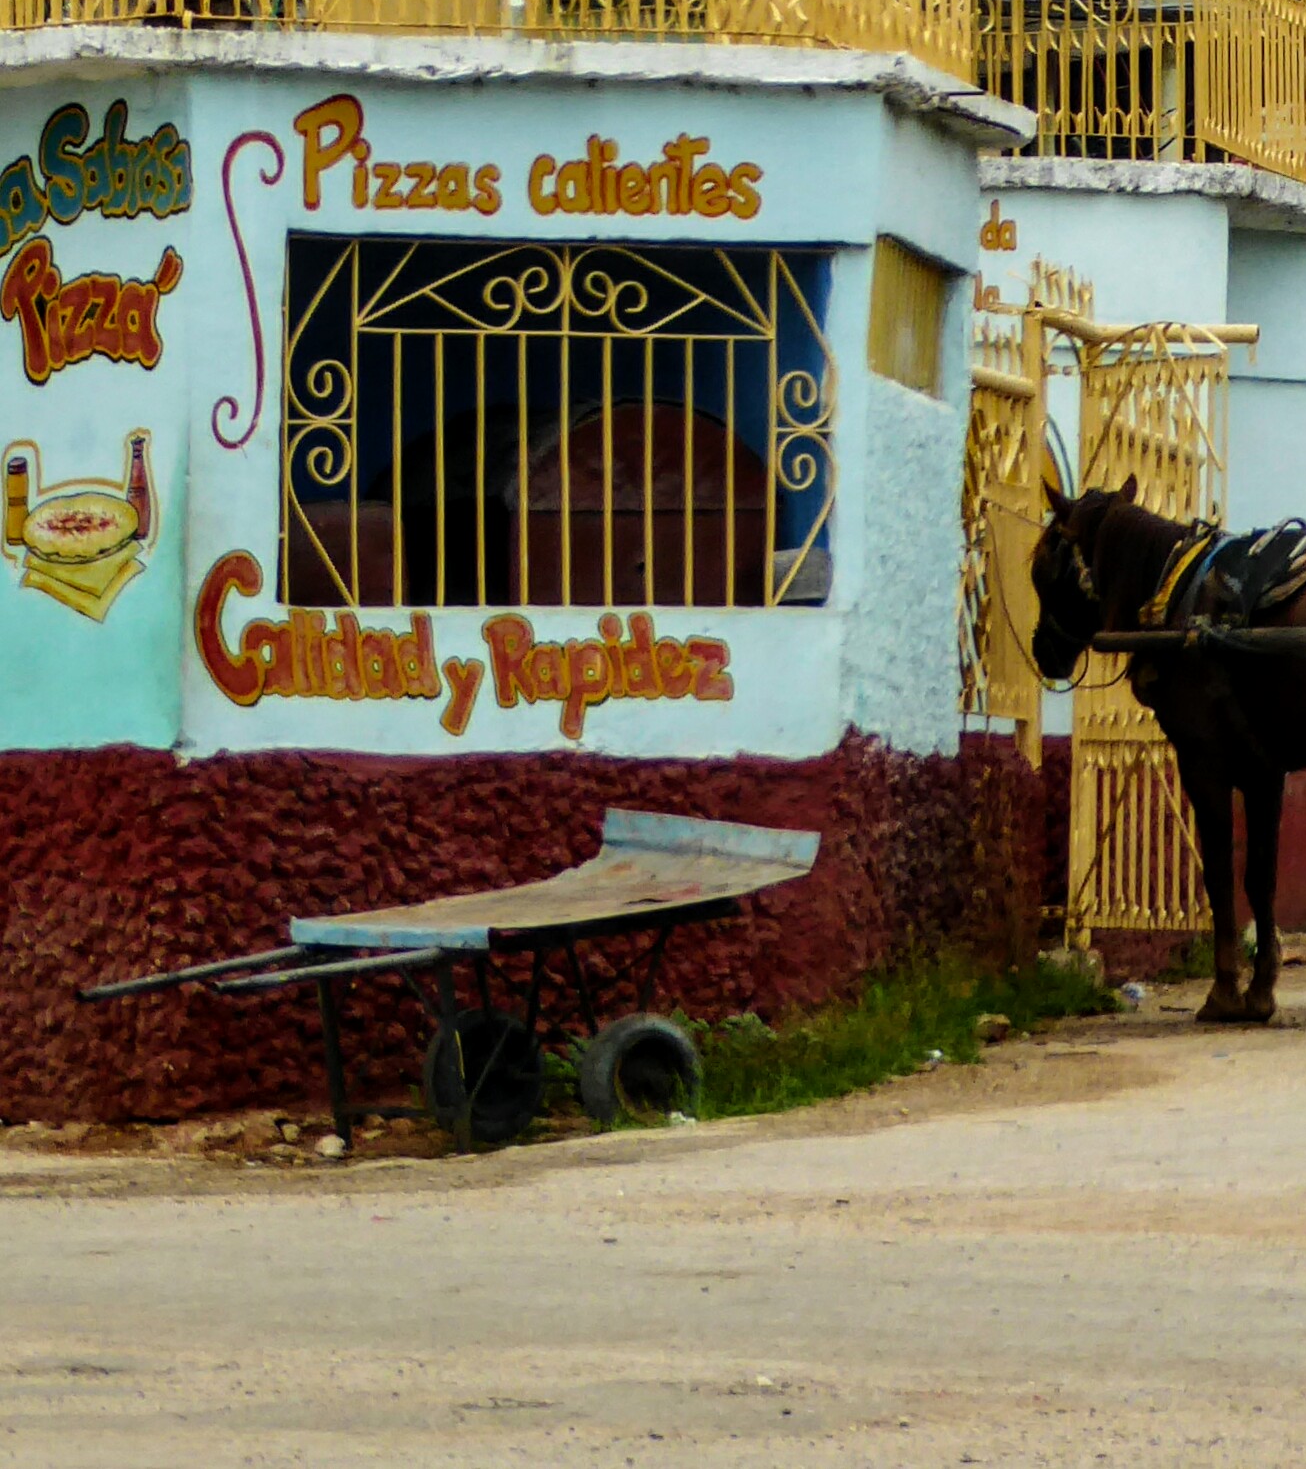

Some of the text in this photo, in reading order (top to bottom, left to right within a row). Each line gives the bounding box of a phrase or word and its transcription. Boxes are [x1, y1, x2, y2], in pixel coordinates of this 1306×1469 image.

[39, 98, 193, 226] Sabrosa
[293, 93, 765, 220] Pizzas calientes
[195, 549, 734, 739] Calidad y Rapidez
